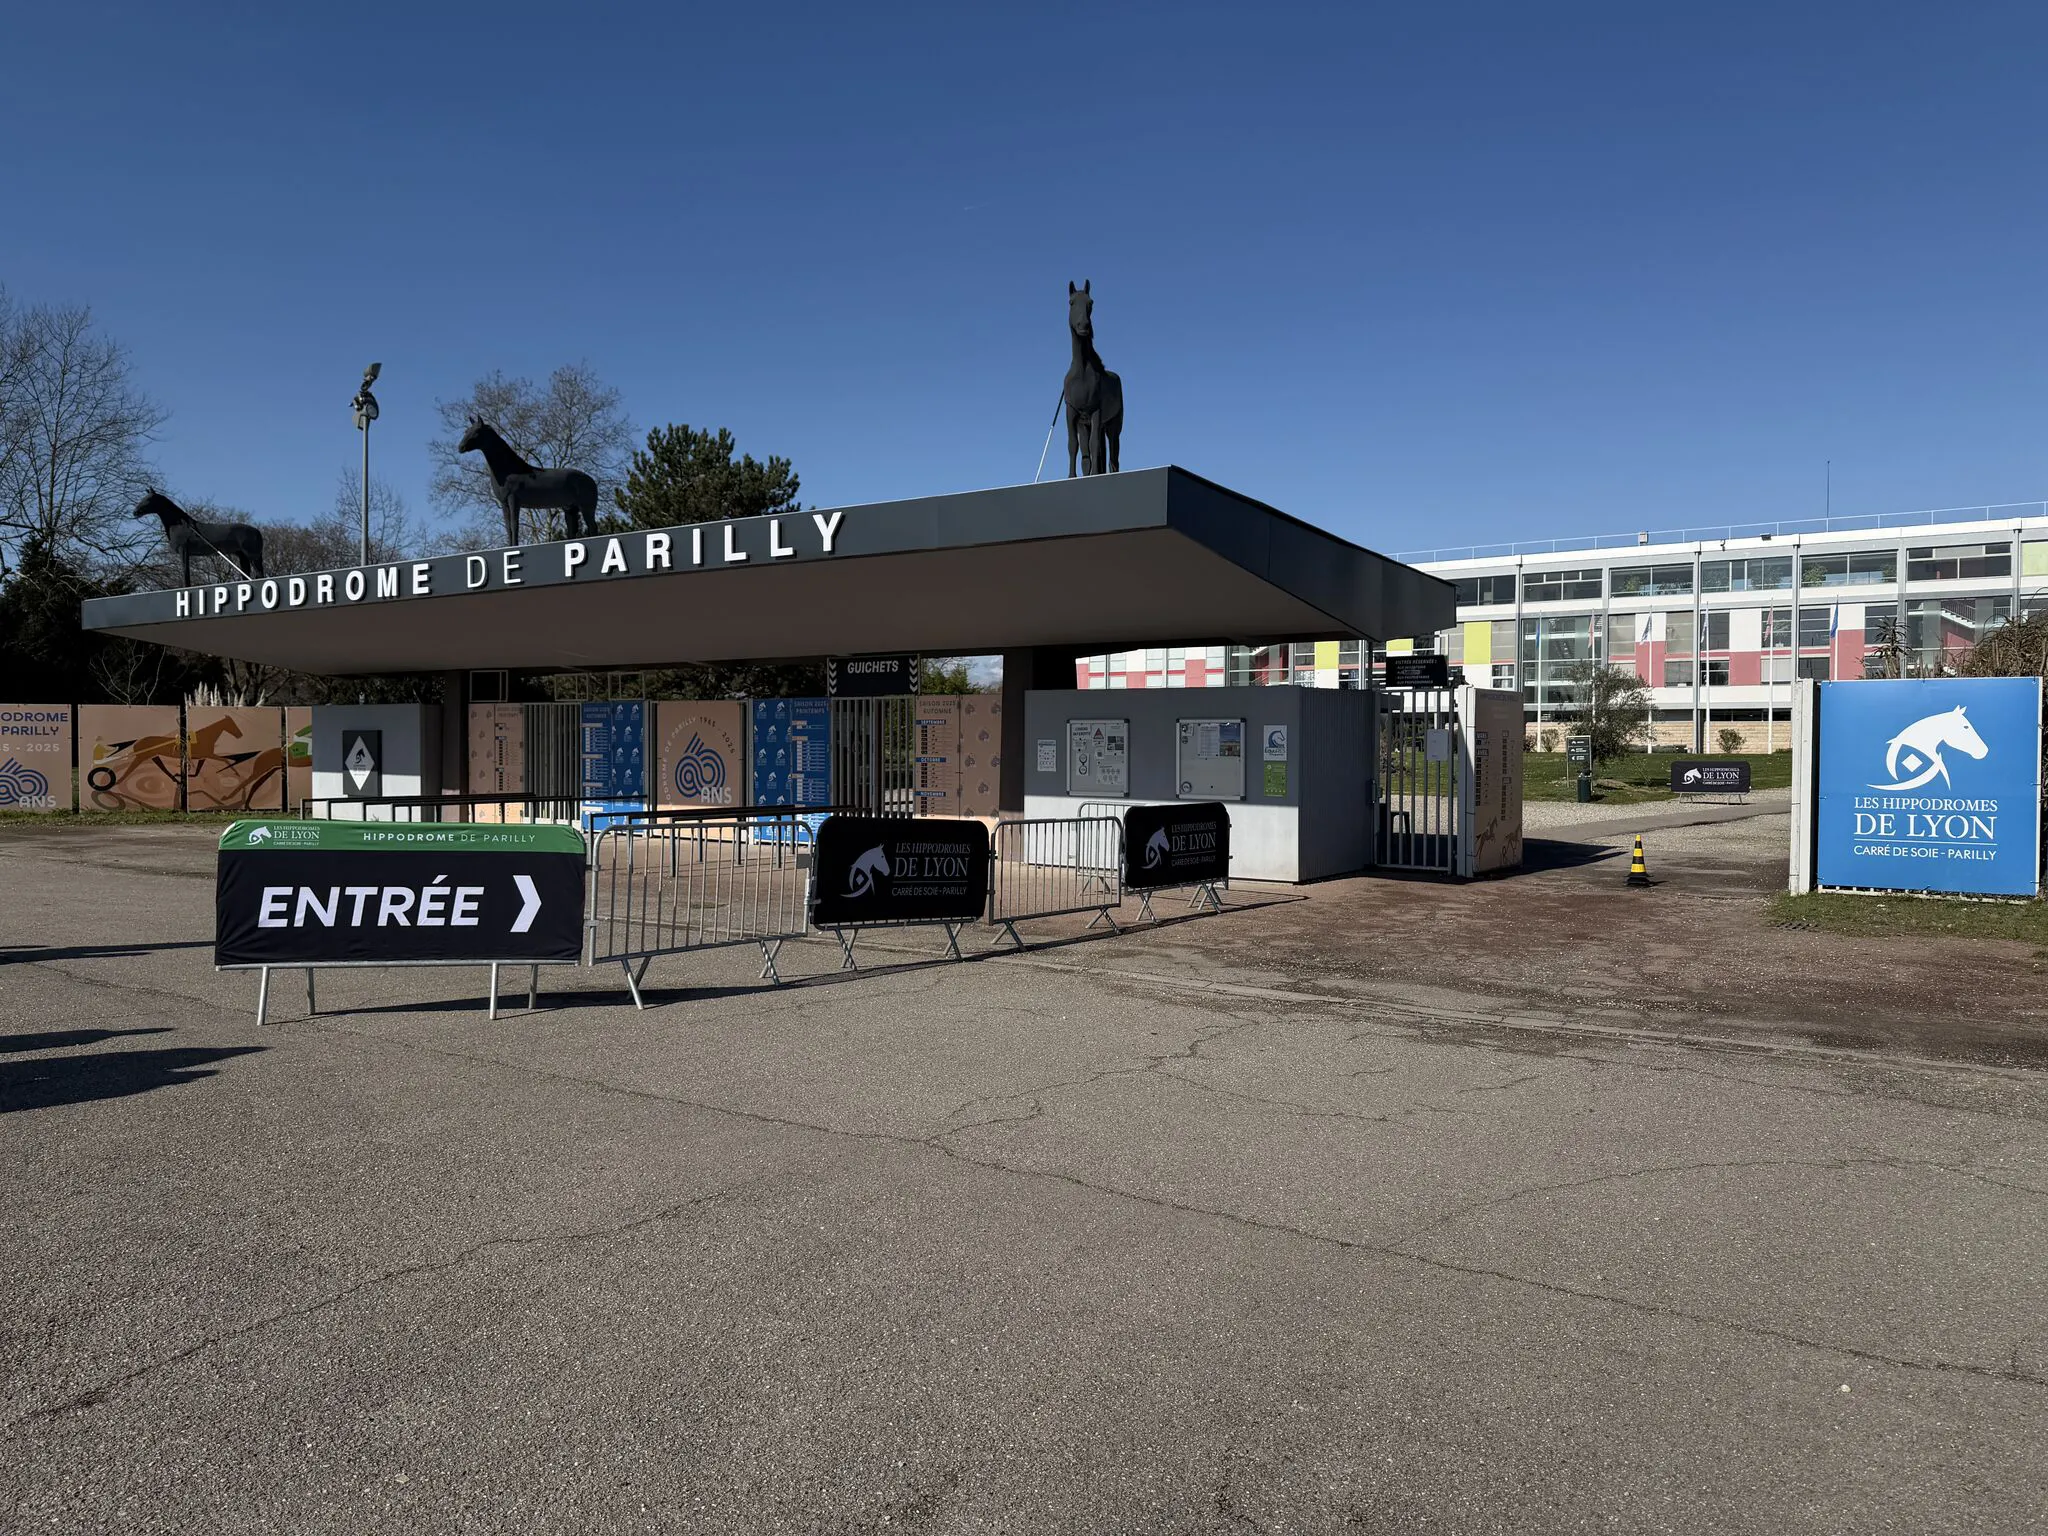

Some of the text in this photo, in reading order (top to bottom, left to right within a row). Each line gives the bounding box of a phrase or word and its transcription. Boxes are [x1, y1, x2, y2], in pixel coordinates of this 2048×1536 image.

[175, 511, 843, 618] HIPPODROME DE PARILLY
[847, 660, 899, 674] GUICHETS
[1, 725, 60, 736] PARILLY
[26, 743, 60, 753] 2025
[1716, 771, 1739, 779] LYON
[19, 795, 57, 808] ANS
[701, 786, 733, 804] ANS
[1854, 796, 1998, 812] LES HIPPODROMES
[1853, 813, 1998, 840] DE LYON
[273, 830, 320, 839] DE LYON
[363, 833, 536, 843] HIPPODROME DE PARILLY
[895, 842, 971, 854] LES HIPPODROMES
[1171, 832, 1216, 852] DE LYON
[1853, 843, 1890, 856] CARRÉ
[1893, 846, 1909, 857] DE
[1910, 847, 1939, 858] SOIE
[1948, 848, 1997, 861] PARILLY
[894, 856, 969, 877] DE LYON
[891, 884, 912, 897] CARRÉ
[913, 887, 923, 896] DE
[923, 886, 938, 896] SOIE
[942, 886, 967, 896] PARILLY
[257, 874, 485, 928] ENTRÉE
